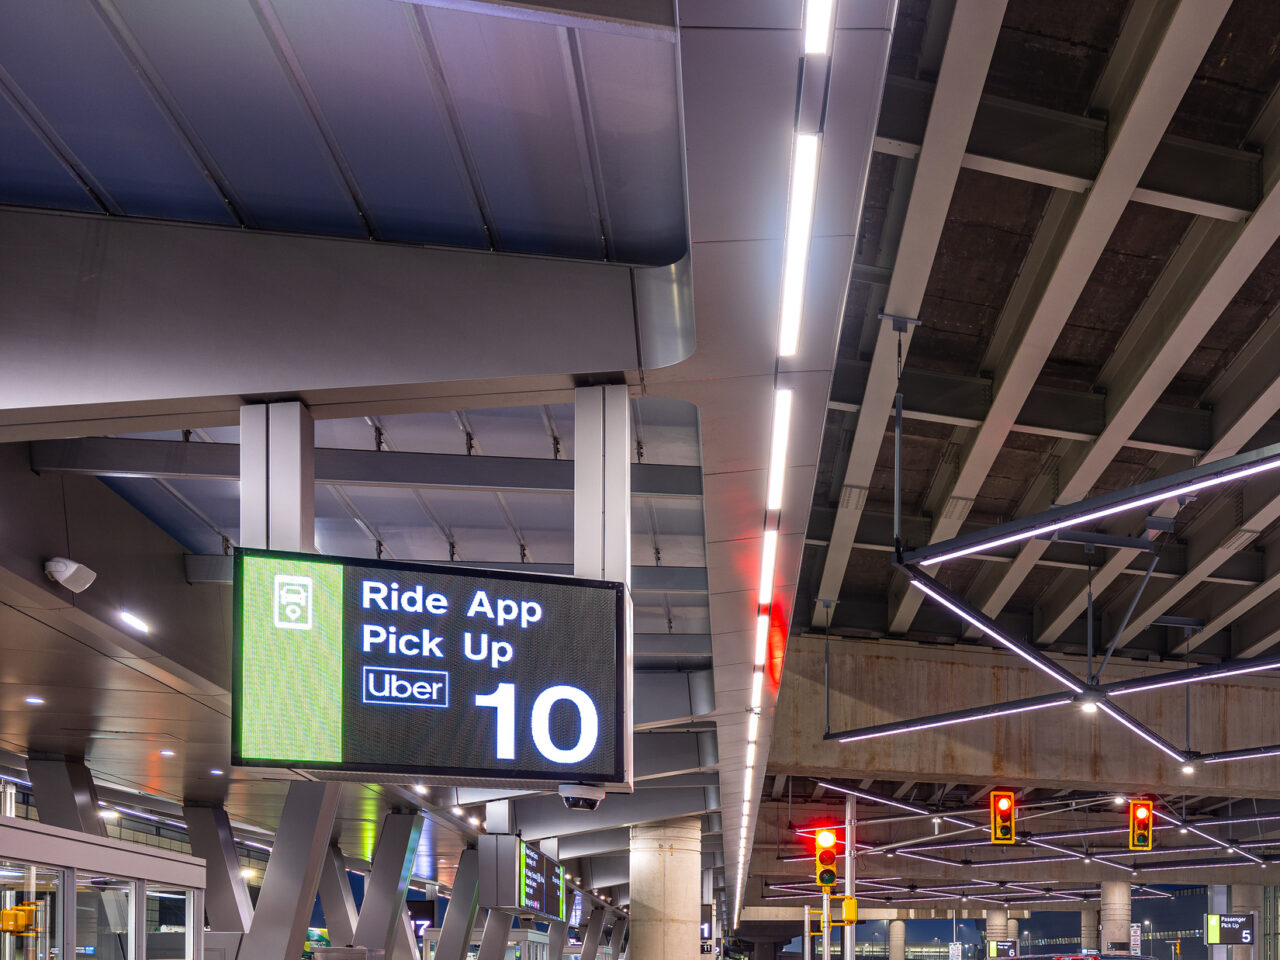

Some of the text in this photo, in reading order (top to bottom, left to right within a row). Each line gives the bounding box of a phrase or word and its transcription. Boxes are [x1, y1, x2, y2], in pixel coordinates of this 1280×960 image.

[362, 580, 543, 629] Ride App
[362, 624, 514, 669] Pick Up
[368, 672, 443, 701] Uber
[475, 682, 599, 764] 10
[1008, 948, 1016, 957] 6
[1241, 929, 1252, 943] 5
